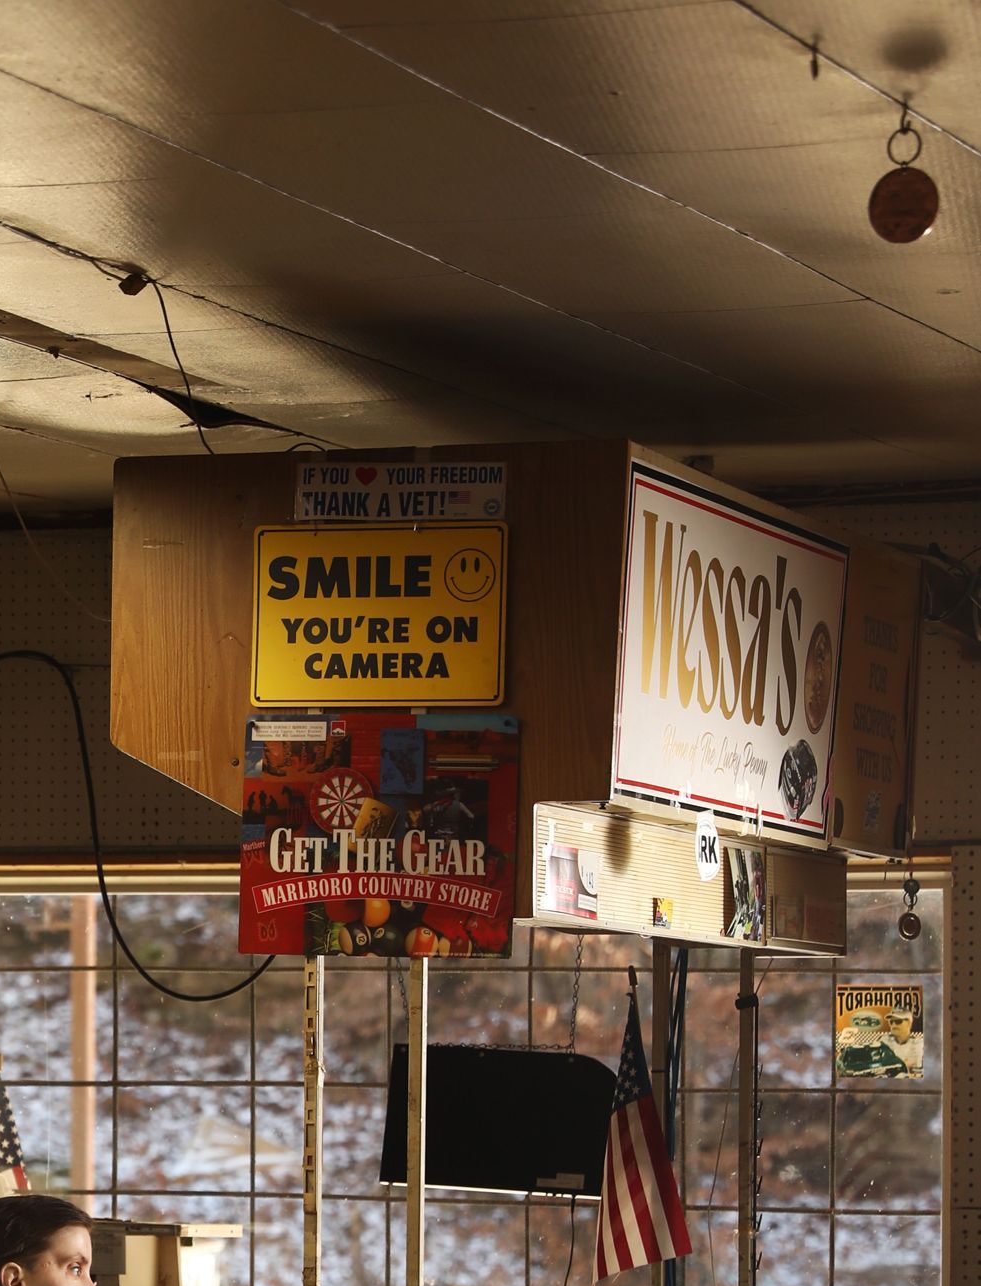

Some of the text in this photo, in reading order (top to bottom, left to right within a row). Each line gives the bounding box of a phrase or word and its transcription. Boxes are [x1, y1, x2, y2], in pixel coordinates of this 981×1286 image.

[303, 466, 502, 485] IF YOU YOUR FREEDOM
[302, 491, 447, 517] THANK A VET!
[267, 555, 433, 601] SMILE
[281, 615, 479, 645] YOU'RE ON
[640, 509, 802, 737] Wessa's
[863, 615, 899, 654] THANKS
[304, 652, 450, 680] CAMERA
[868, 662, 888, 694] FOR
[853, 701, 896, 740] SHOPPING
[701, 731, 717, 773] The
[714, 736, 742, 785] Lucky
[742, 741, 769, 790] Penny
[855, 747, 893, 784] WITH US
[269, 827, 487, 876] GET THE GEAR
[261, 876, 493, 911] MARLBORO COUNTRY STORE
